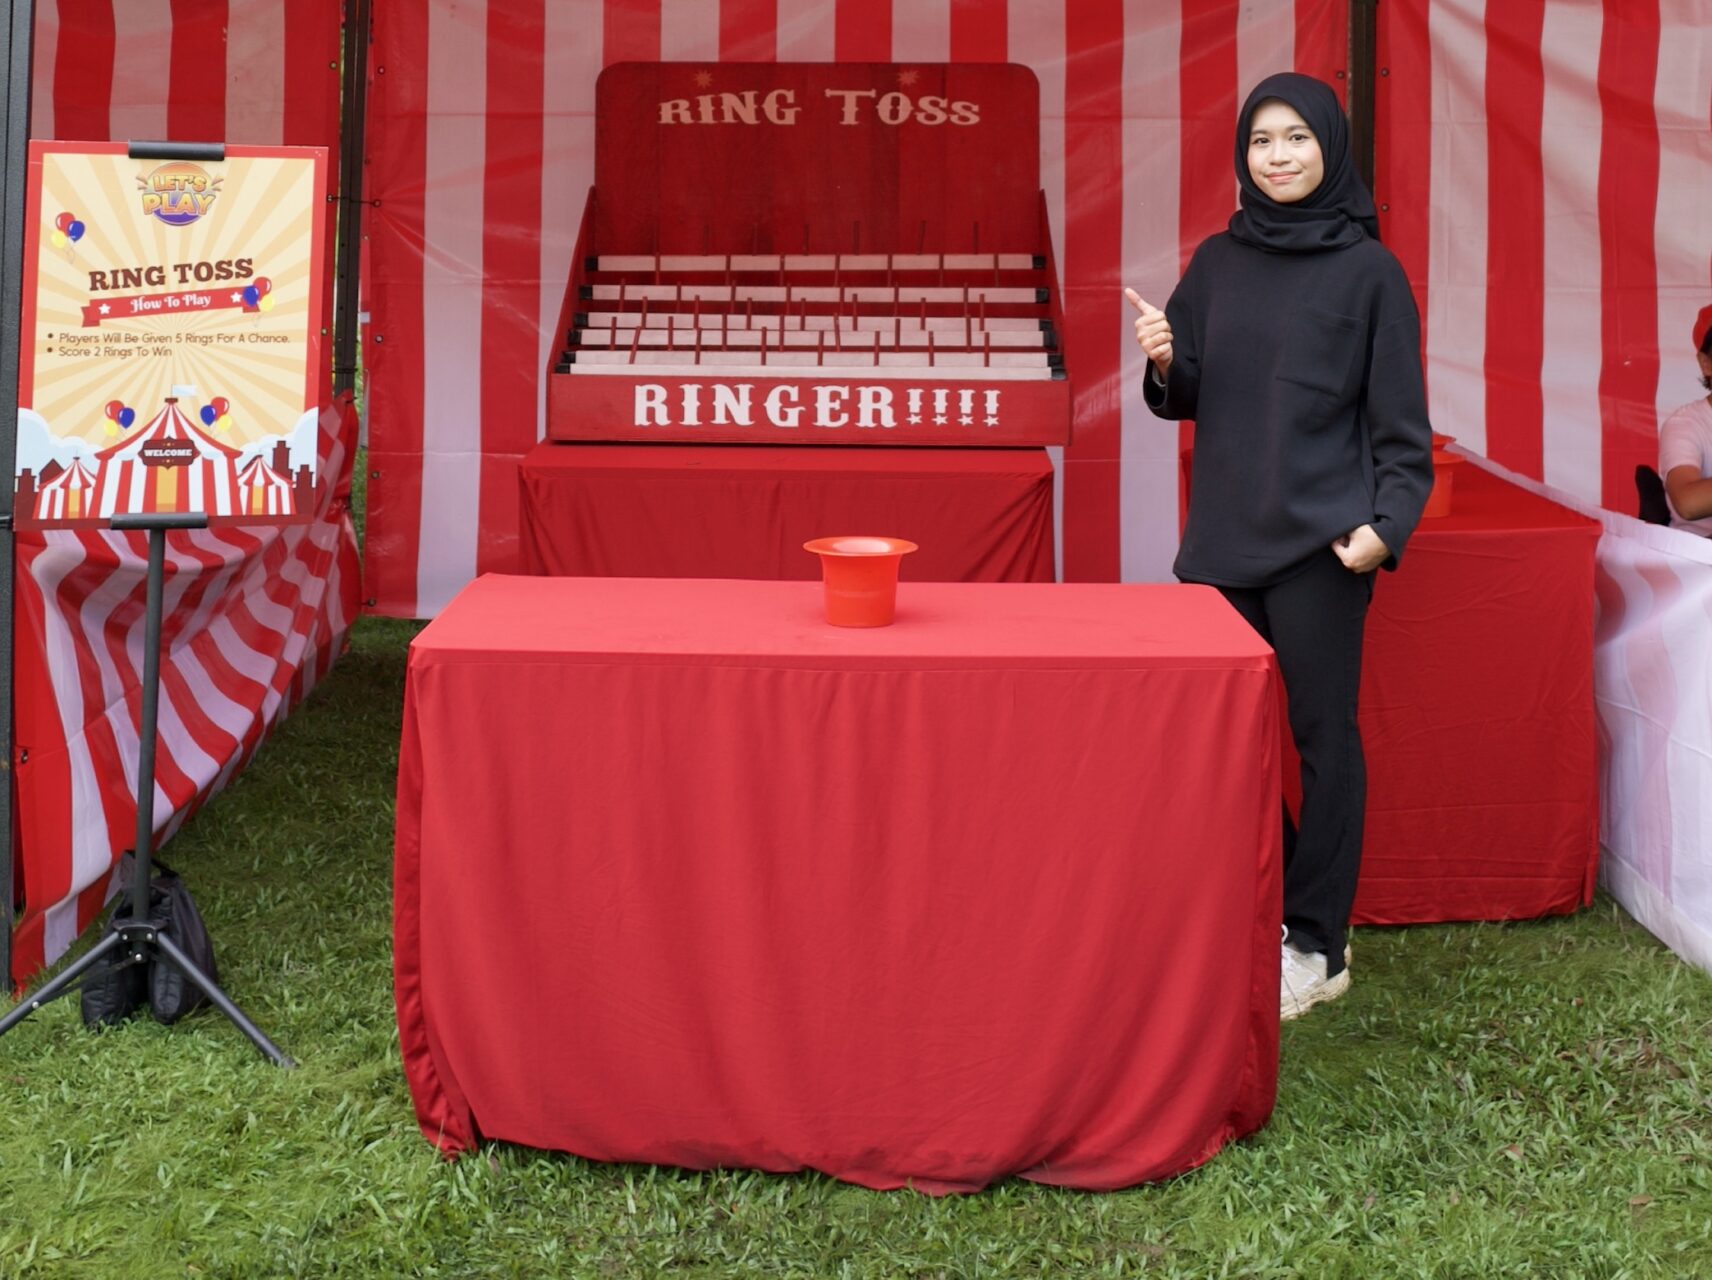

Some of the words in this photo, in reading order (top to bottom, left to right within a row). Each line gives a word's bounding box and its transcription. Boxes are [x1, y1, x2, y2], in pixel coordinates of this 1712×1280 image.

[658, 89, 801, 125] RING
[825, 88, 981, 125] TOSS
[152, 175, 207, 192] LET'S
[142, 192, 216, 215] PLAY
[89, 266, 166, 291] RING
[174, 258, 254, 283] TOSS
[130, 296, 162, 313] How
[164, 296, 180, 308] To
[182, 294, 211, 308] Play
[59, 333, 100, 346] Players
[104, 333, 122, 343] Will
[124, 333, 139, 343] Be
[142, 333, 172, 343] Given
[175, 333, 183, 343] 5
[185, 333, 213, 346] Rings
[217, 333, 235, 343] For
[238, 333, 245, 343] A
[59, 347, 91, 357] Score
[94, 347, 101, 357] 2
[103, 347, 132, 360] Rings
[136, 347, 149, 357] To
[153, 346, 172, 357] Win
[634, 383, 1001, 427] RINGER!!!!
[143, 448, 193, 457] WELCOME
